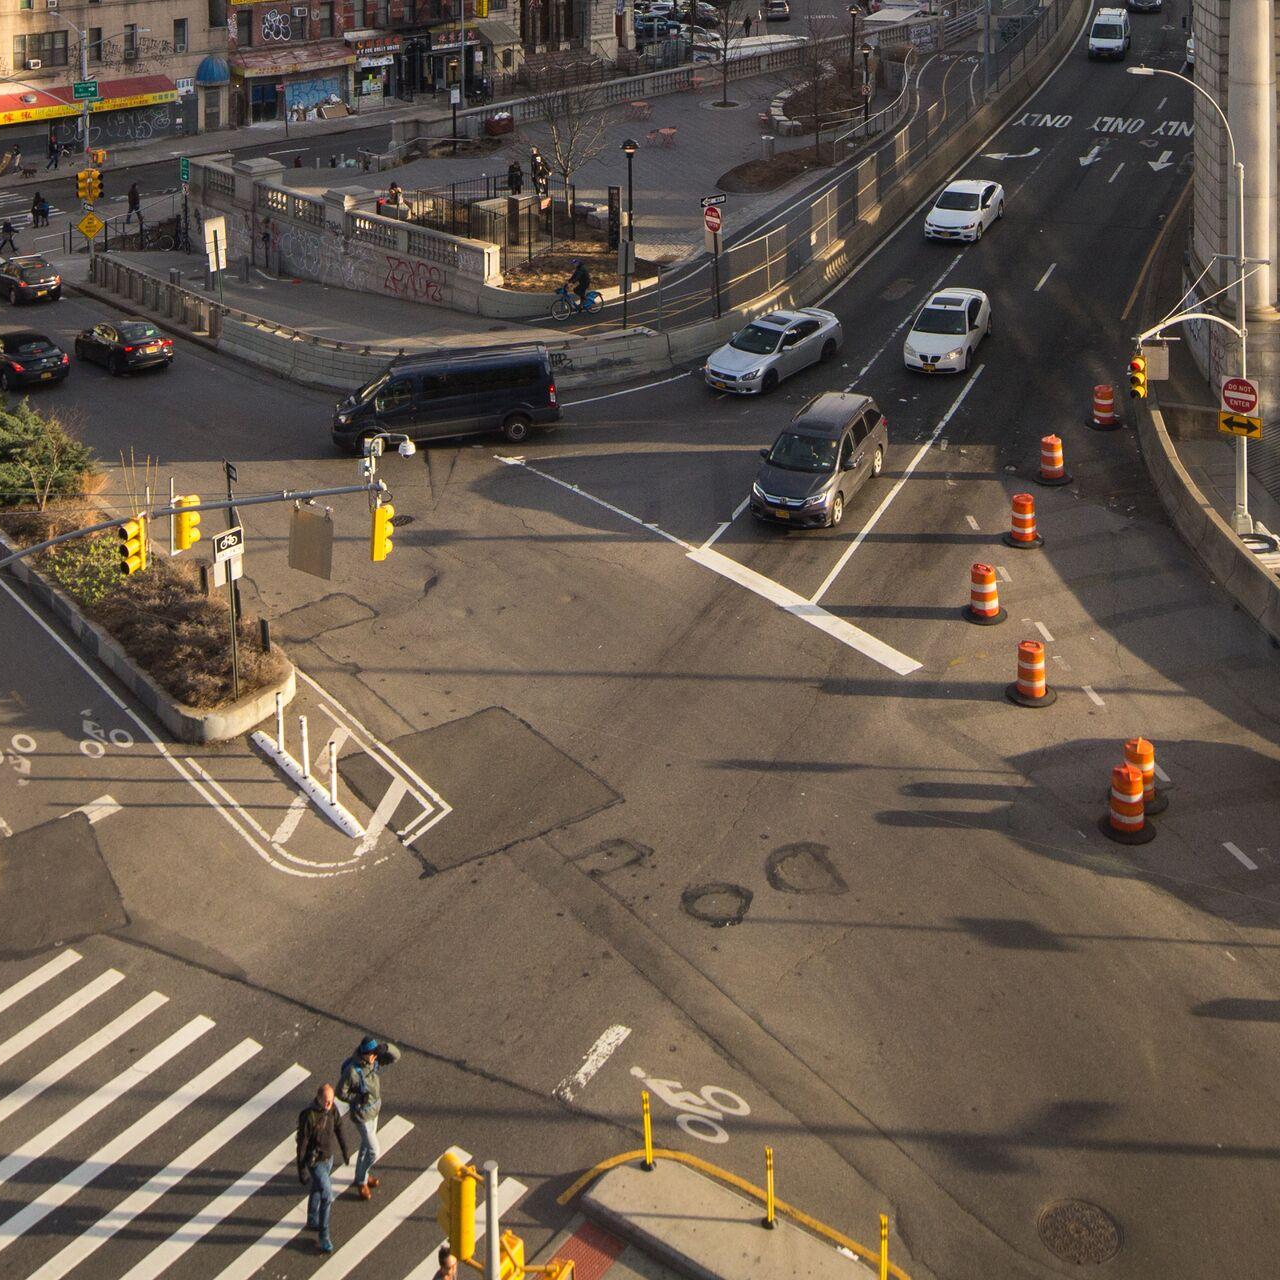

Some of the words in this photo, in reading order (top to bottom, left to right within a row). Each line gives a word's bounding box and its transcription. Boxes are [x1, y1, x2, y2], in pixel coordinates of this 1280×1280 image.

[1012, 112, 1073, 128] ONLY
[1085, 116, 1146, 134] ONLY
[1151, 120, 1194, 137] NLY
[1230, 399, 1250, 407] ENTER
